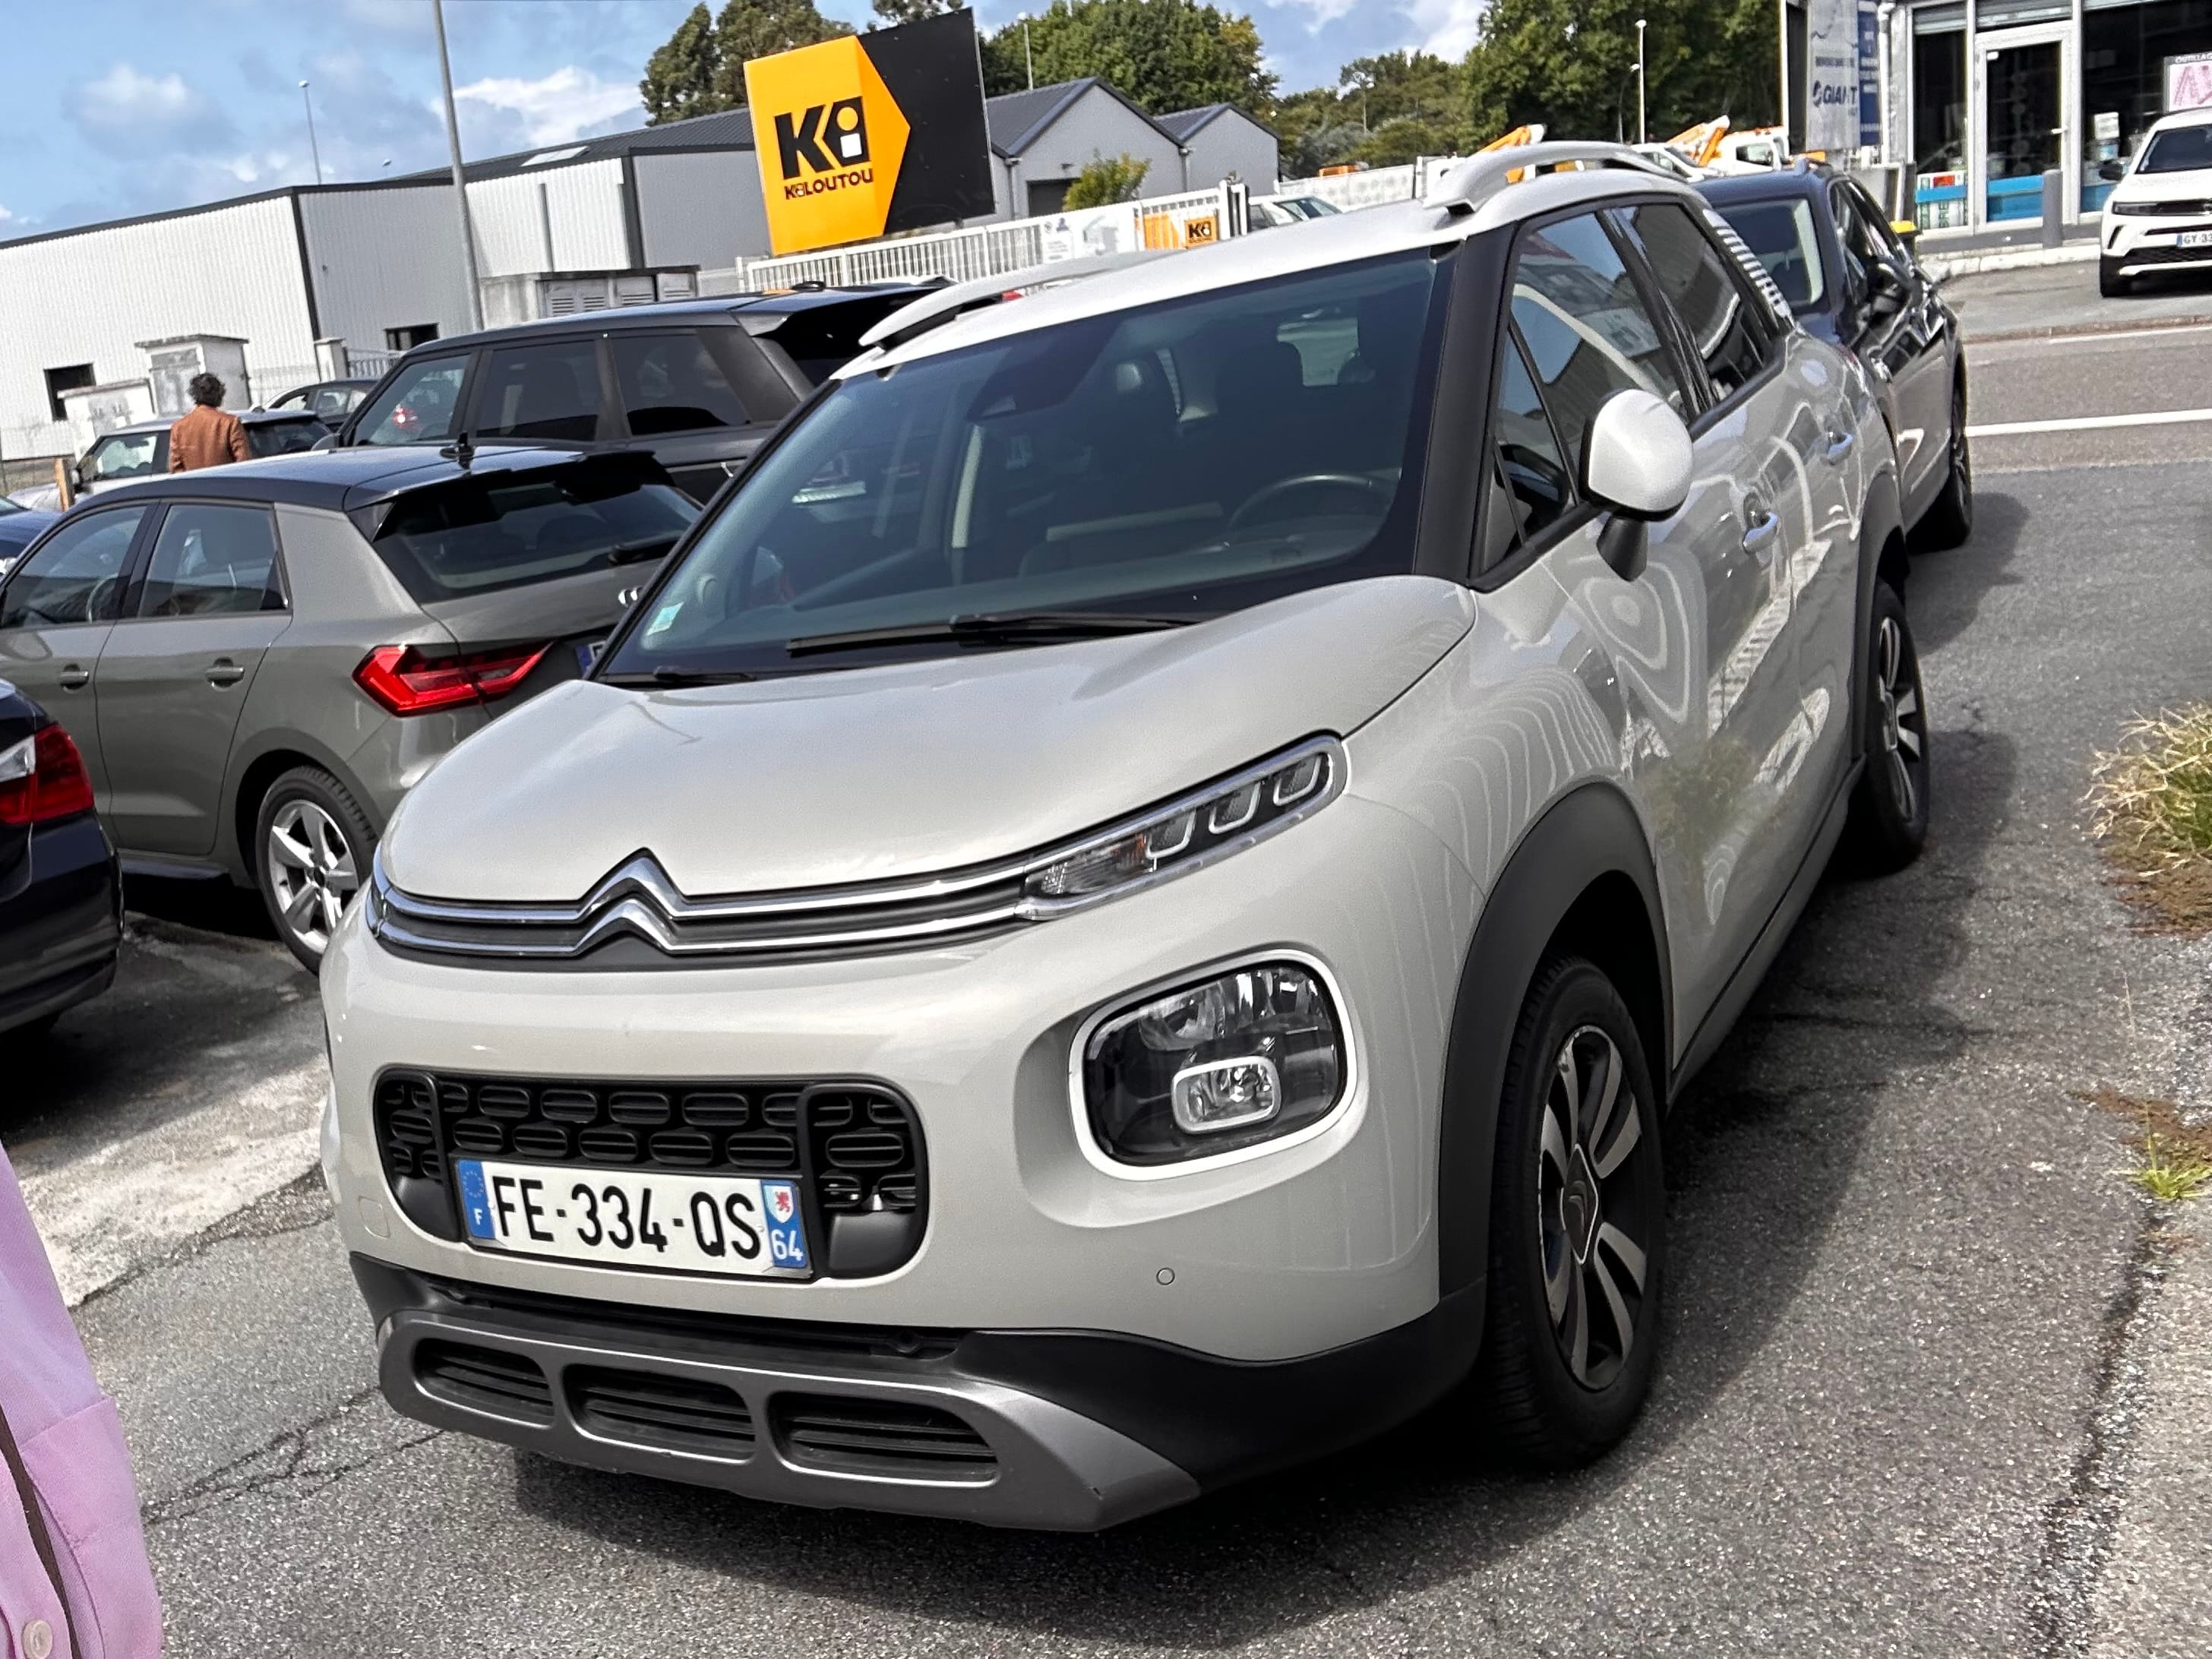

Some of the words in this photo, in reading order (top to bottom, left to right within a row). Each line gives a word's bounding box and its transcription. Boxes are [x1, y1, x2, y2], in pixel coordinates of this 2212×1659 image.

[473, 1207, 483, 1226] F
[491, 1175, 760, 1260] FE-334-QS
[772, 1229, 804, 1262] 64
